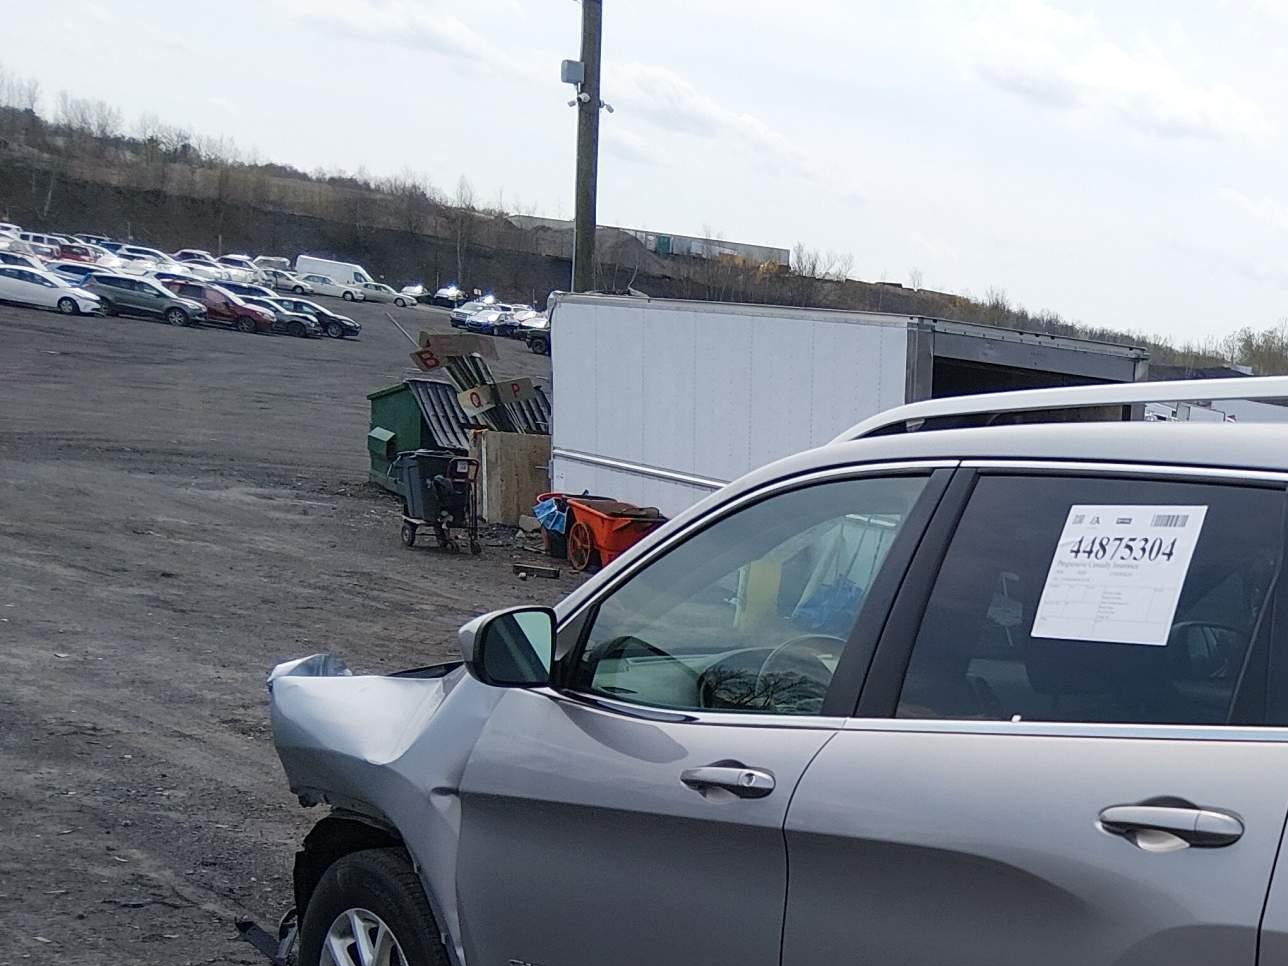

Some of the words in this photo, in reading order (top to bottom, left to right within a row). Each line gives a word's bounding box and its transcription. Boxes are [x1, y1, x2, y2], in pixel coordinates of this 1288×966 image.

[416, 350, 441, 369] B
[511, 383, 521, 398] P
[1069, 535, 1177, 562] 44875304
